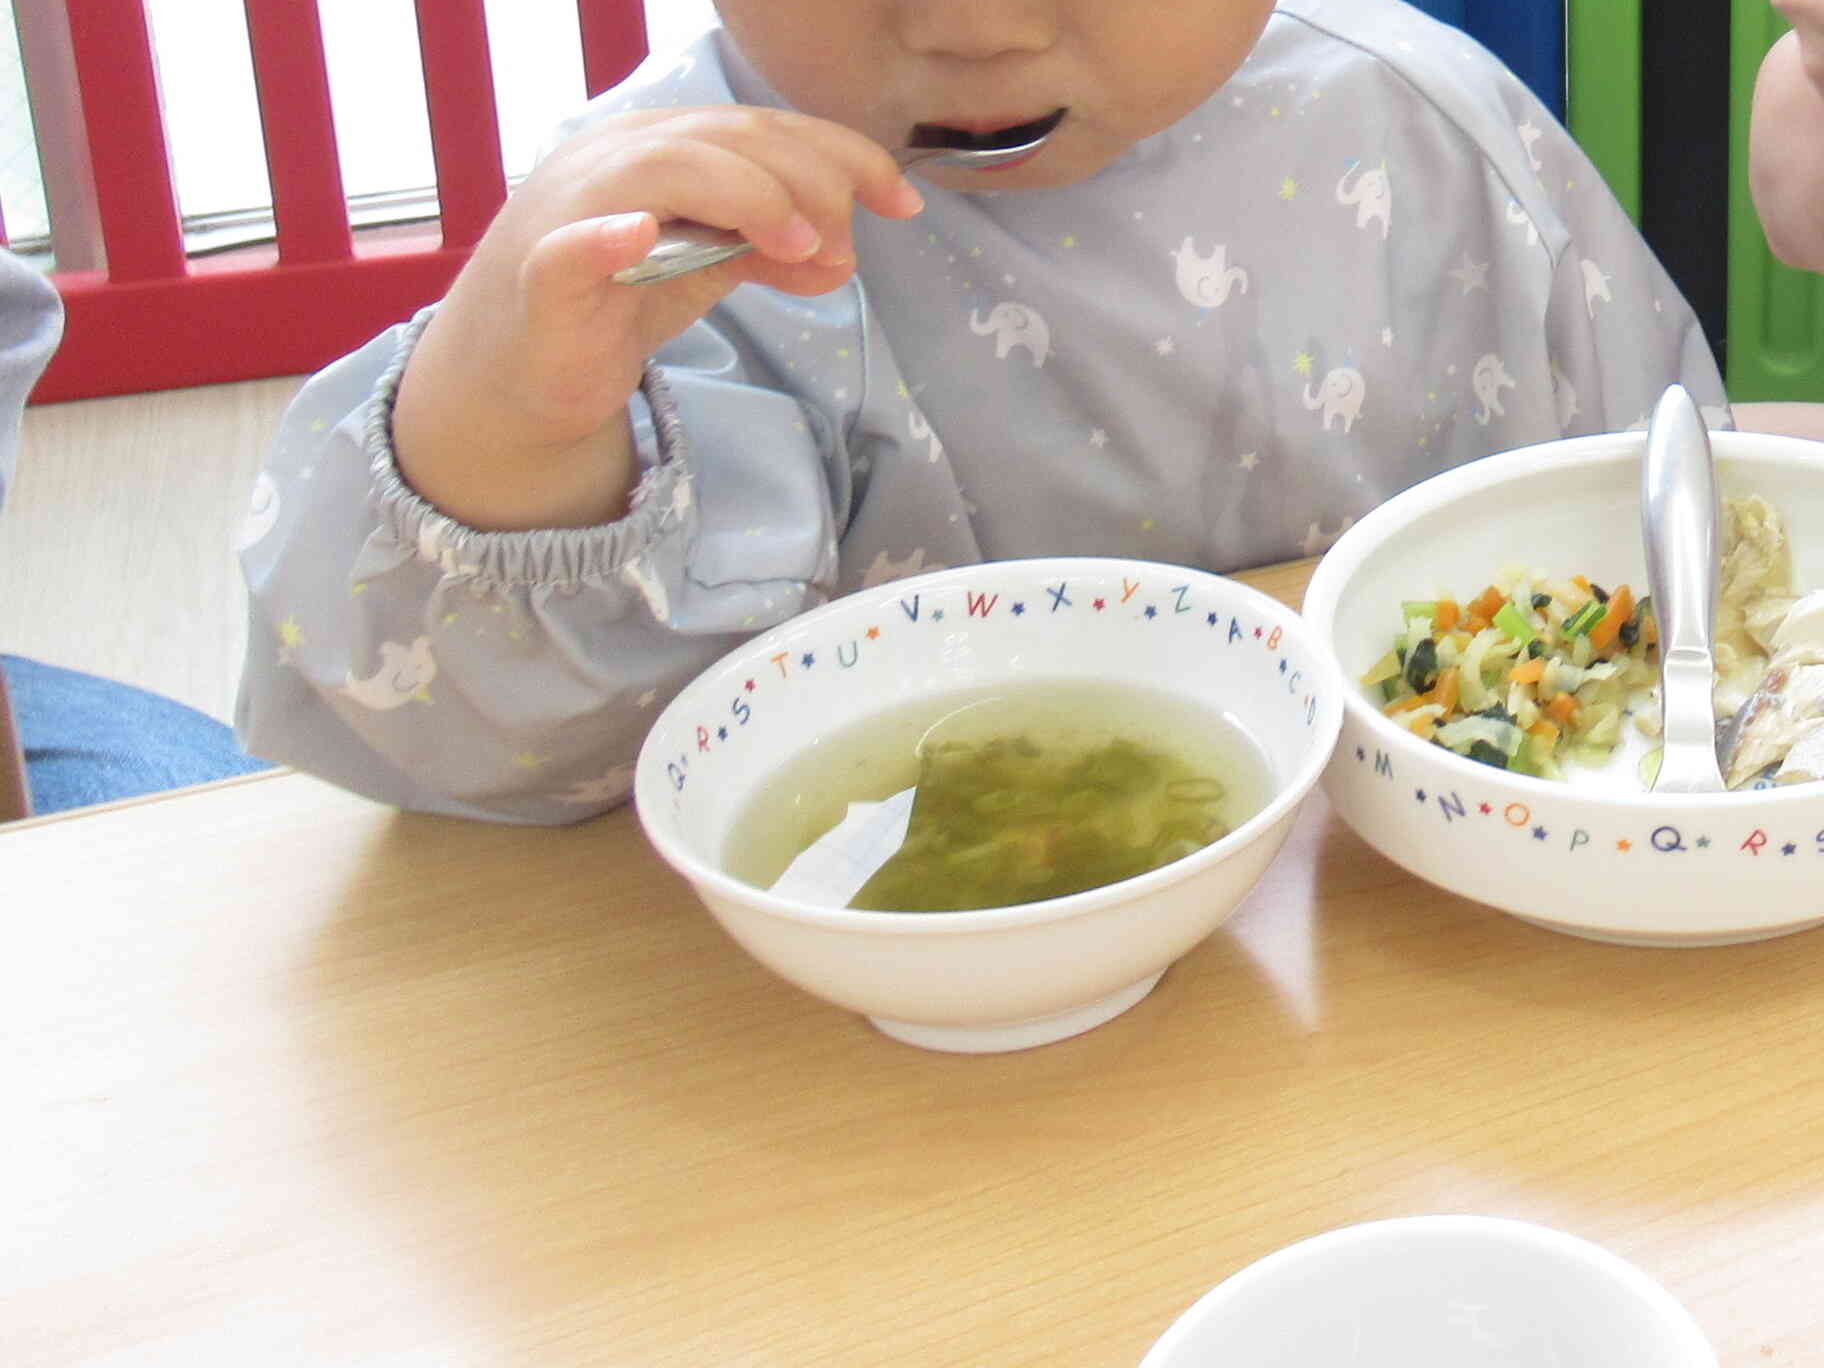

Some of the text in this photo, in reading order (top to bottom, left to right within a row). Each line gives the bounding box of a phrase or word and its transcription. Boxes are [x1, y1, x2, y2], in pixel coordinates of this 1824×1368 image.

[696, 725, 711, 753] R
[732, 697, 751, 726] S
[770, 651, 789, 679] T
[837, 640, 858, 669] U
[900, 593, 920, 623] V
[966, 591, 999, 619] W
[1045, 581, 1073, 614] X
[1121, 577, 1141, 604] Y
[1171, 584, 1192, 614] Z
[1227, 616, 1243, 645] A
[1266, 625, 1284, 651] B
[1374, 748, 1394, 781] M
[1437, 791, 1467, 823] N
[1503, 802, 1531, 827] O
[1569, 829, 1590, 852] P
[1650, 825, 1689, 853] Q
[1740, 829, 1768, 857] R
